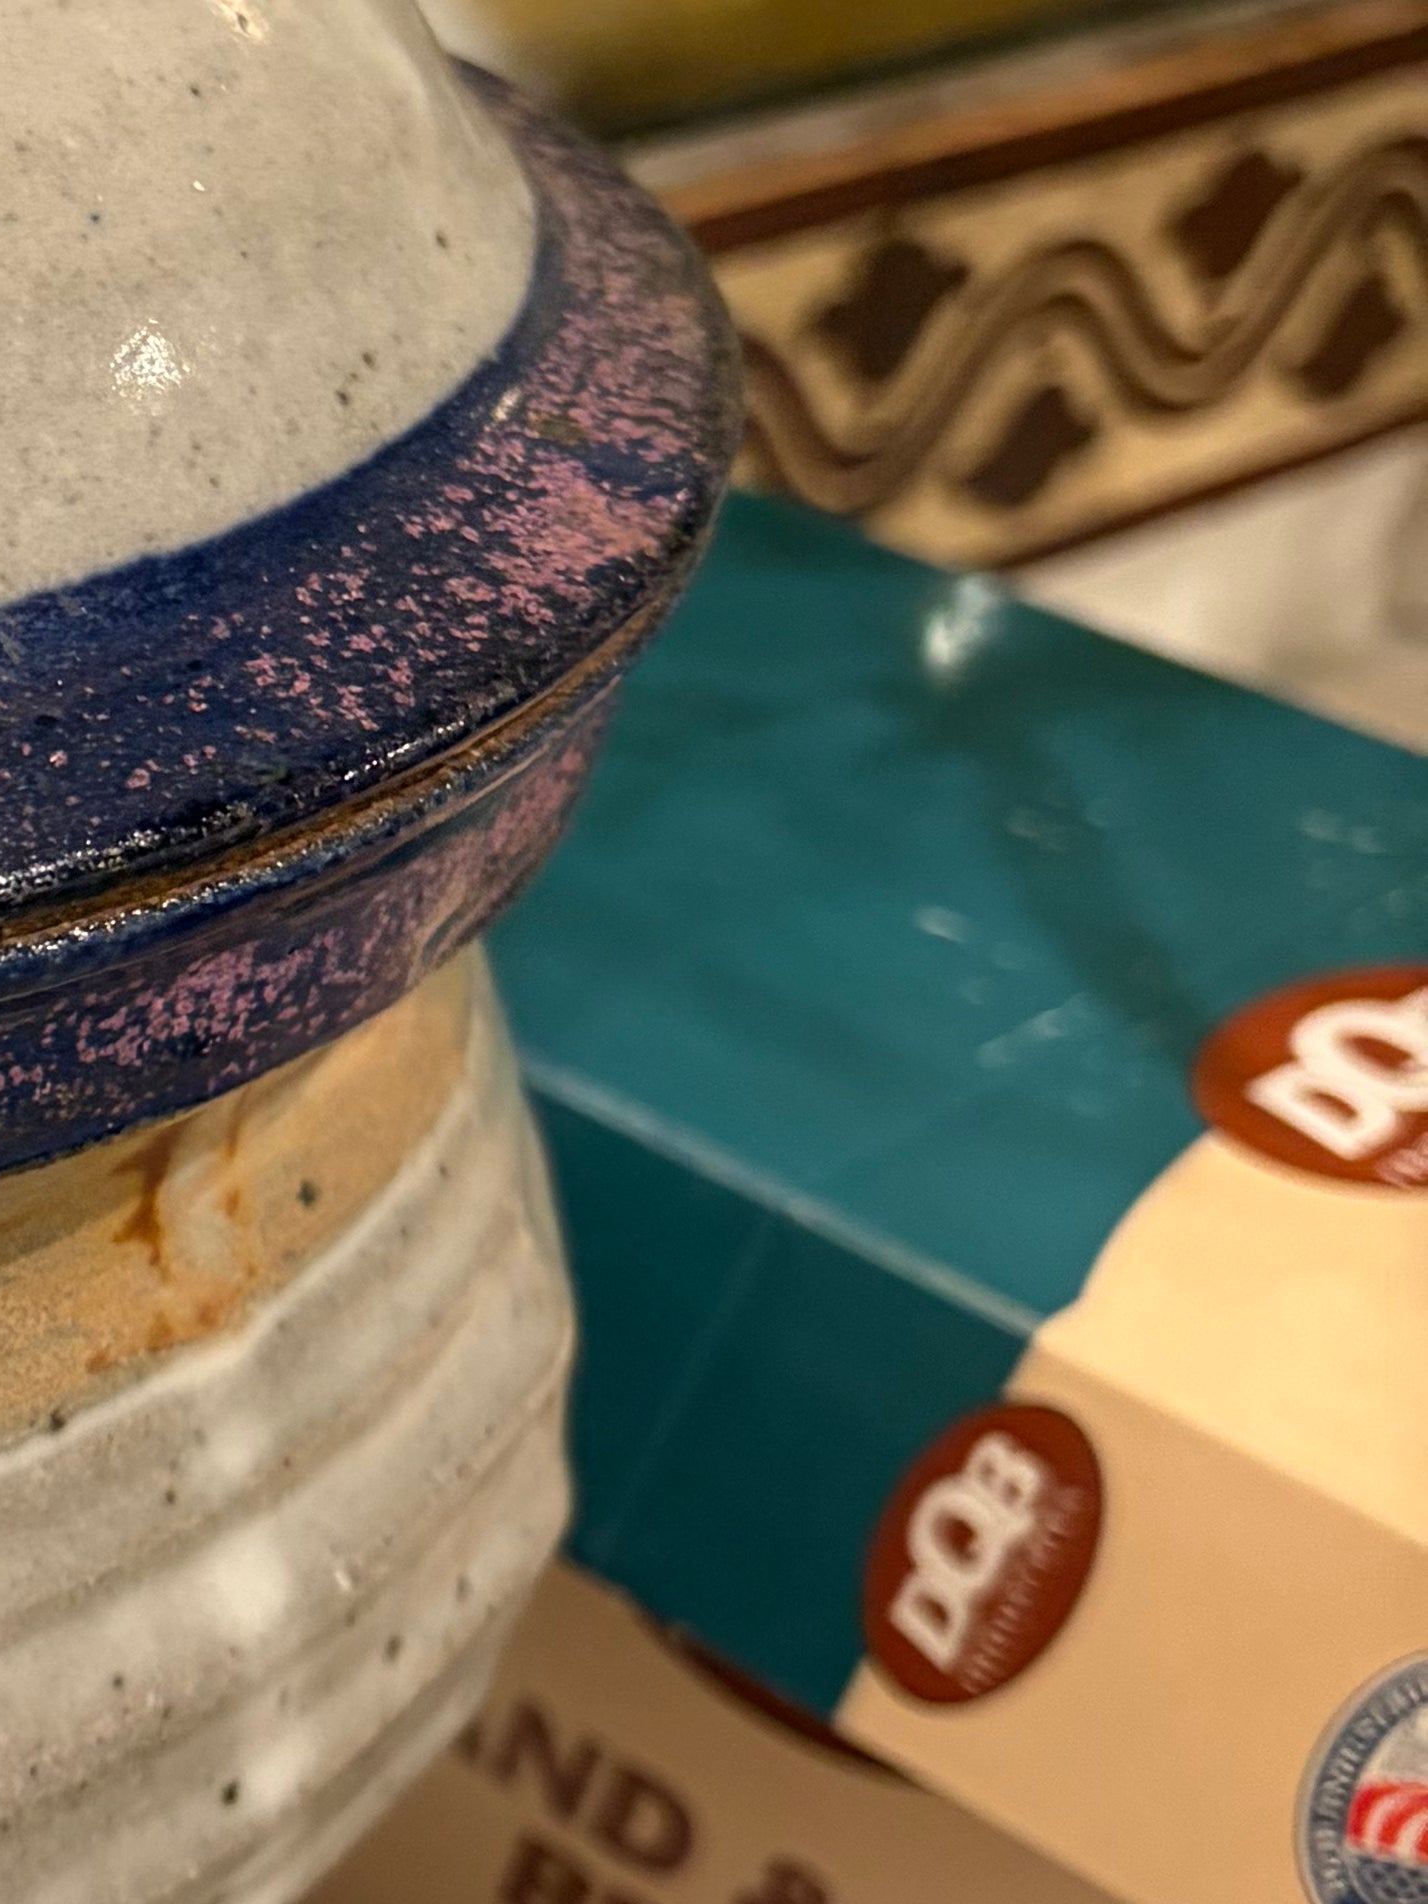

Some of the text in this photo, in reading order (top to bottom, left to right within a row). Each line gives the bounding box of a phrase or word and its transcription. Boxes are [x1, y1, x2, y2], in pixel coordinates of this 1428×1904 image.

[1245, 984, 1428, 1160] DO
[889, 1432, 1038, 1672] DOB
[452, 1699, 696, 1875] ND
